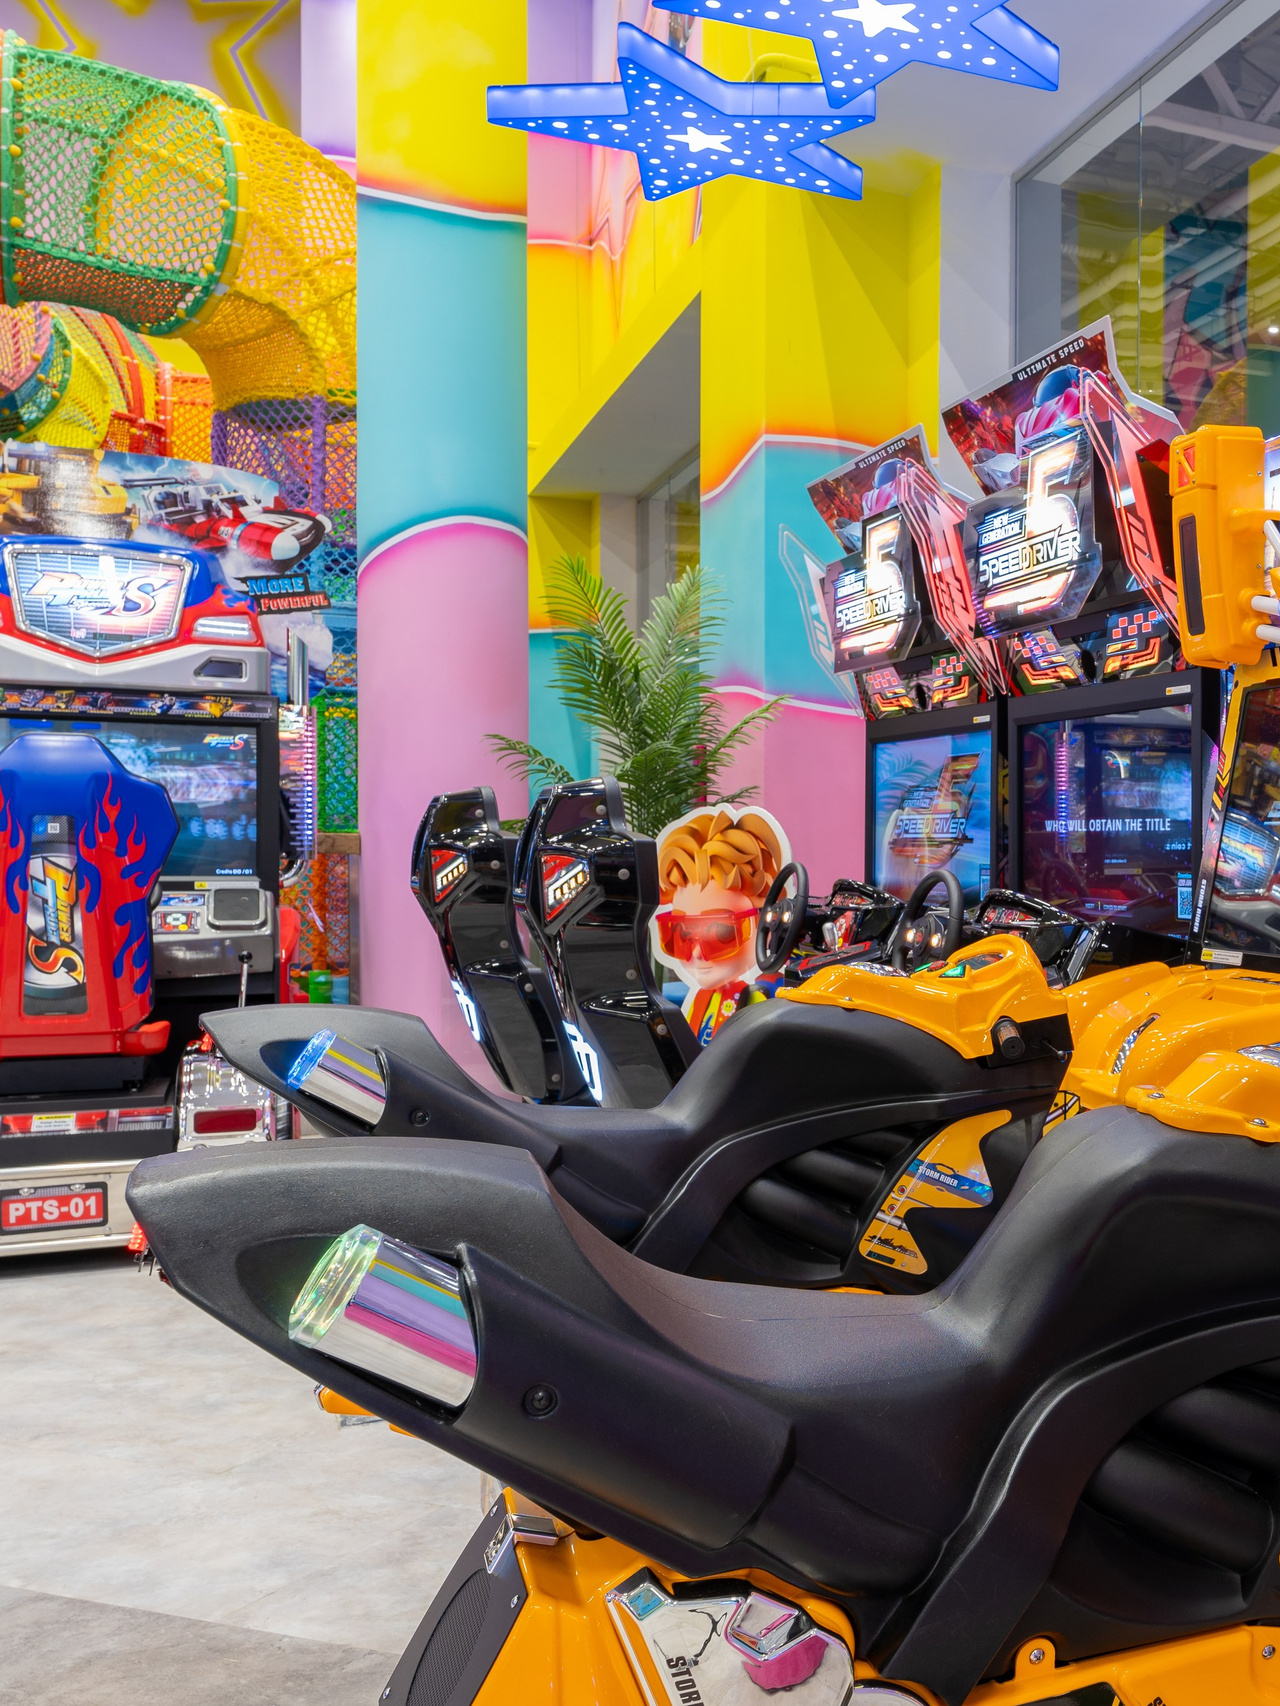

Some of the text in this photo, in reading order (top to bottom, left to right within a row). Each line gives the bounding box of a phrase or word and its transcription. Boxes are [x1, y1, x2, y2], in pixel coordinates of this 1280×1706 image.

[1017, 339, 1085, 380] ULTIMATE SPEED
[858, 438, 907, 469] ULTIMATE SPEED
[247, 577, 305, 595] MORE
[261, 594, 328, 611] POWERFUL
[1045, 818, 1171, 832] WHO WILL OBTAIN THE TITLE
[1193, 879, 1207, 933] STORM RIDER
[918, 1166, 958, 1187] STORM RIDER
[9, 1196, 96, 1224] PTS-01
[666, 1656, 706, 1706] STOR
